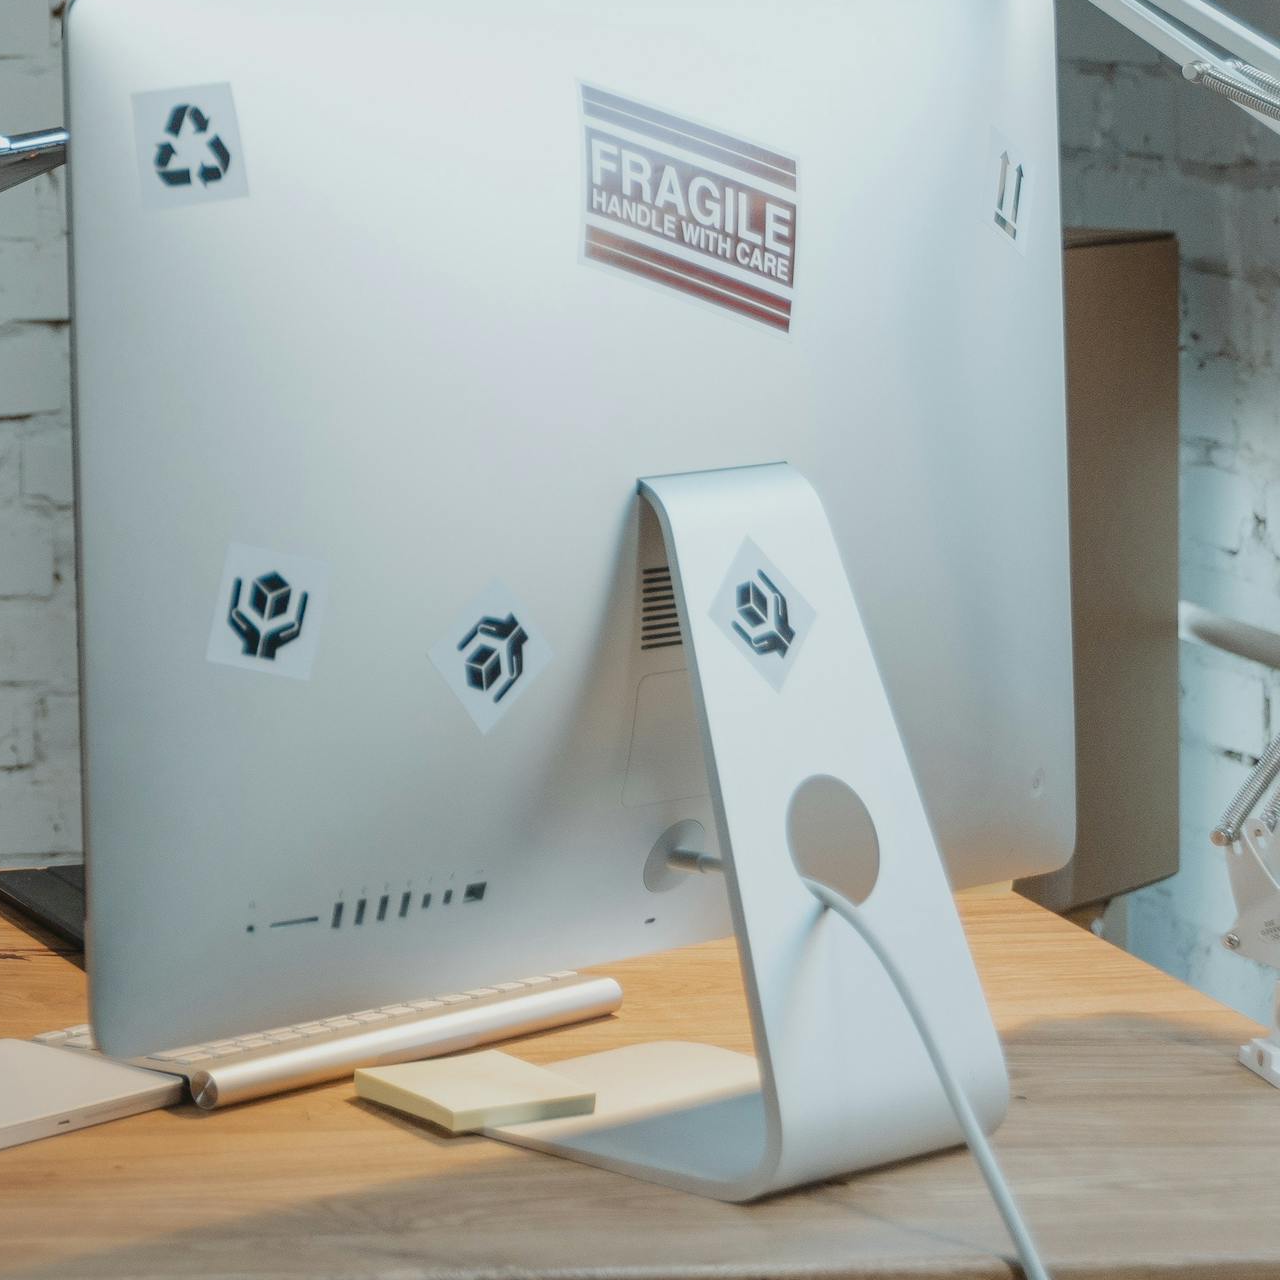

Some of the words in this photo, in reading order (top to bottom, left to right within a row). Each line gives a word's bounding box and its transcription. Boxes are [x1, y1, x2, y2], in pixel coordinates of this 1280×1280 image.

[591, 138, 791, 257] FRAGILE
[593, 187, 676, 238] HANDLE
[680, 220, 732, 259] WITH
[735, 244, 789, 281] CARE
